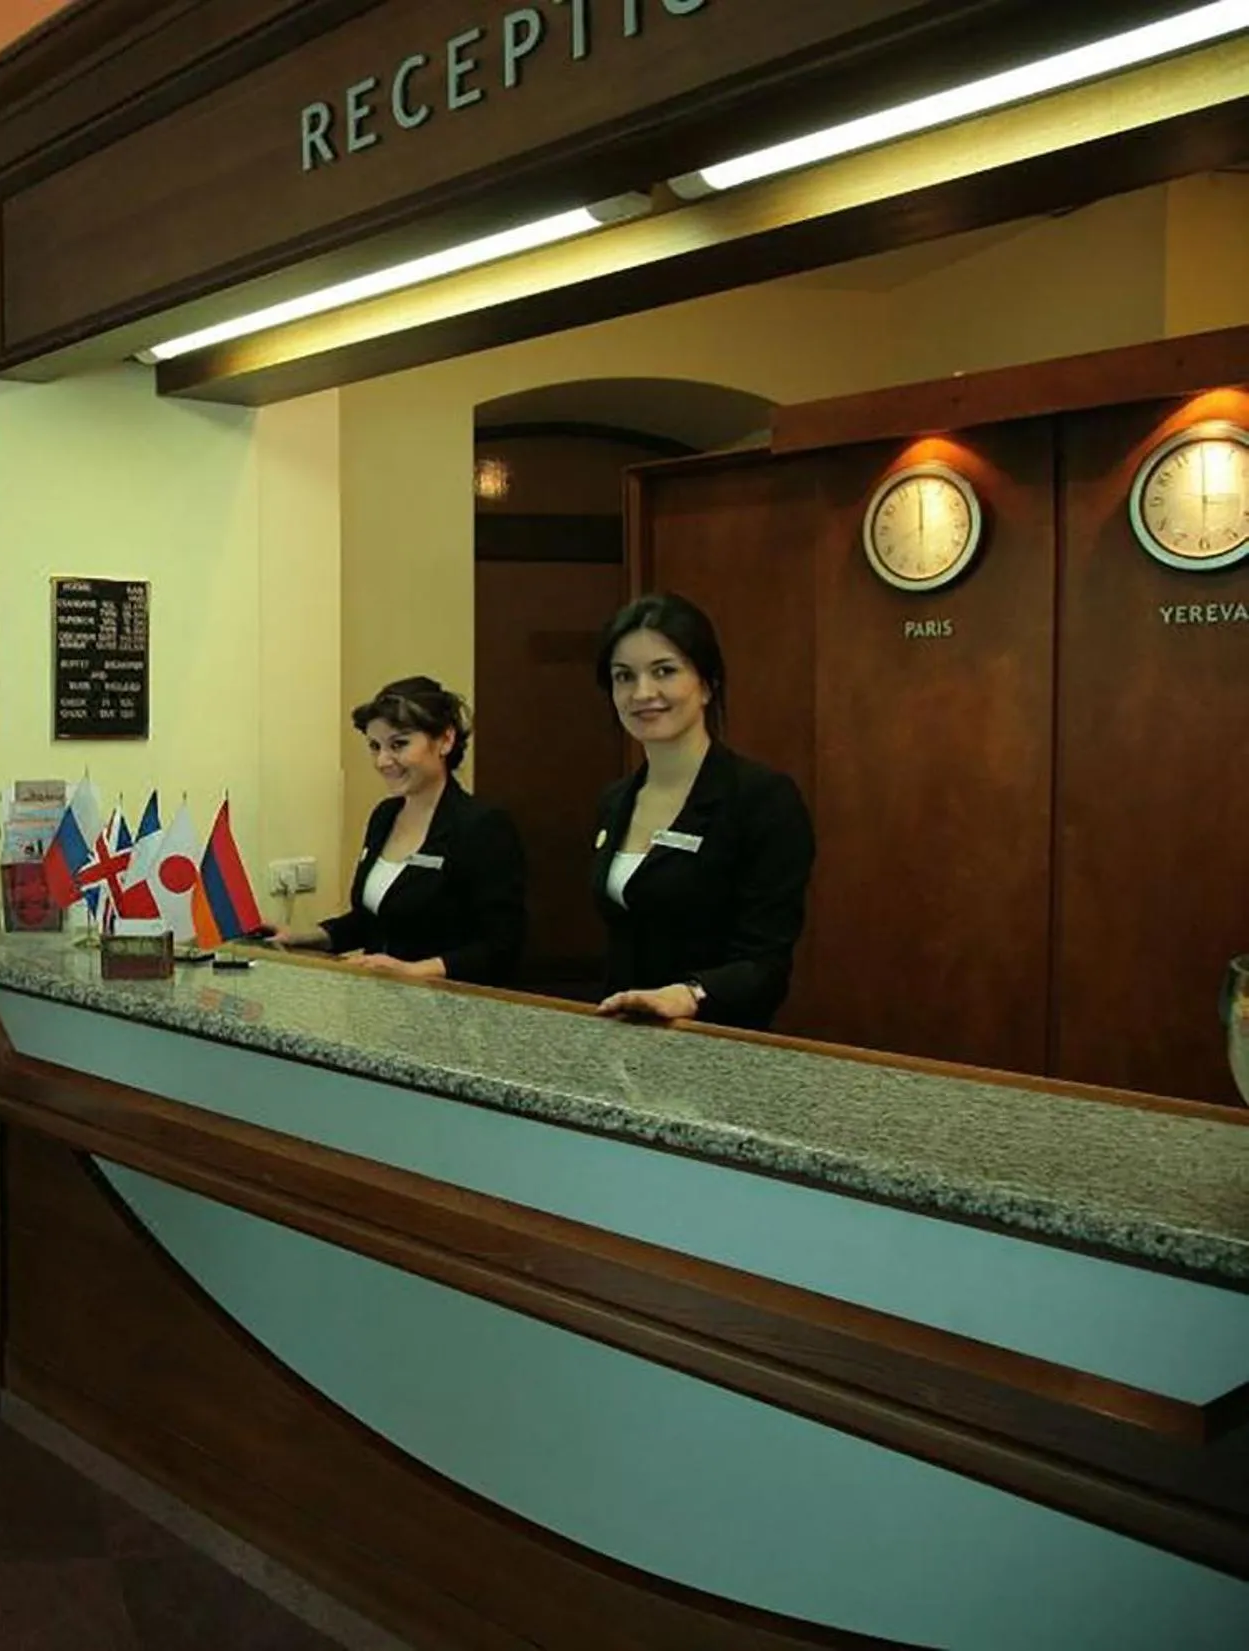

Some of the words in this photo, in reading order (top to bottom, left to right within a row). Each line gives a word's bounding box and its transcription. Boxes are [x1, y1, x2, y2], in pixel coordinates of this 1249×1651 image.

[301, 0, 707, 171] RECEPT
[1159, 603, 1249, 625] YEREVA
[904, 619, 953, 639] PARIS
